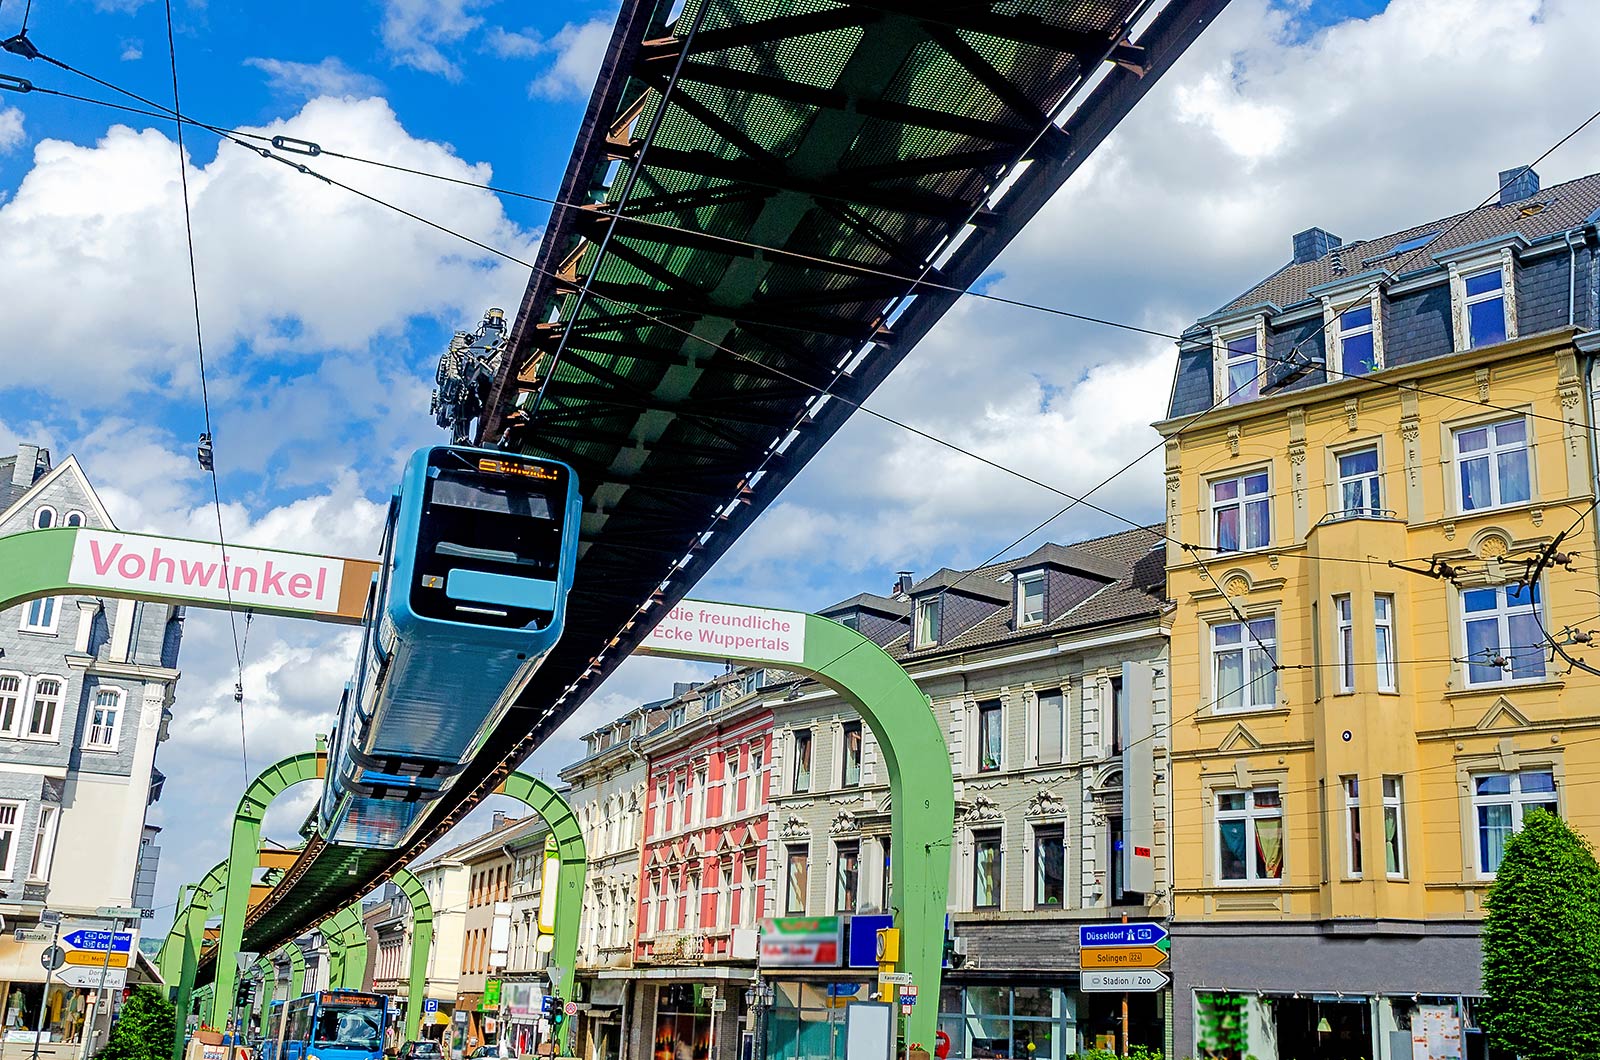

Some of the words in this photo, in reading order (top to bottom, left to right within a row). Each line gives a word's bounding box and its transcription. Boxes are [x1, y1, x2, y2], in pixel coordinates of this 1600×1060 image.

[90, 540, 327, 600] Vohwinkel
[669, 607, 694, 621] die
[699, 609, 790, 632] freundliche
[653, 625, 693, 641] Ecke
[698, 628, 790, 651] Wuppertals
[924, 799, 930, 809] 9
[98, 932, 130, 941] Dormund
[1086, 930, 1124, 940] Düsseldorf
[96, 941, 116, 949] Essn
[1097, 953, 1127, 963] Solingen
[88, 977, 121, 986] Vohinkel
[1103, 976, 1129, 985] Stadion
[1137, 976, 1151, 985] Zoo
